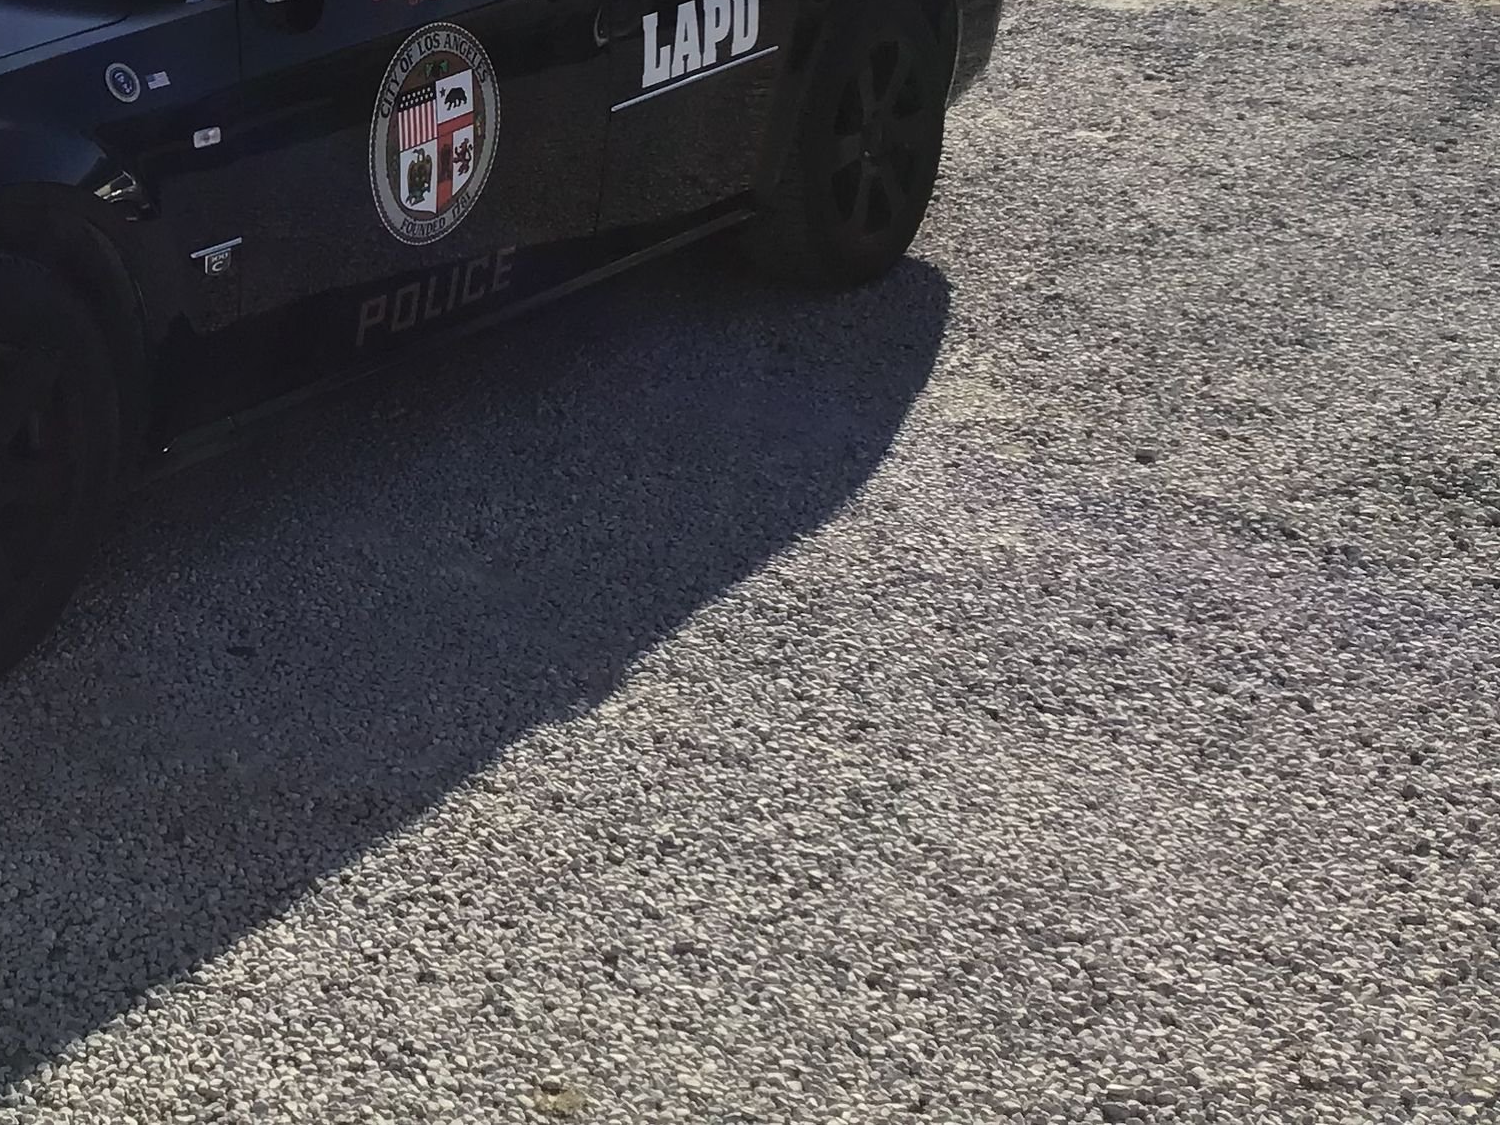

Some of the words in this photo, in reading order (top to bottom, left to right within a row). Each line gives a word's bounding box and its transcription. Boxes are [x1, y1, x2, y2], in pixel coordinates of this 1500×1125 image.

[379, 74, 400, 118] CITY
[399, 47, 415, 73] OF
[417, 32, 441, 54] LOS
[443, 32, 488, 84] ANGELES
[400, 217, 446, 236] FOUNDED
[356, 244, 517, 347] POLICE
